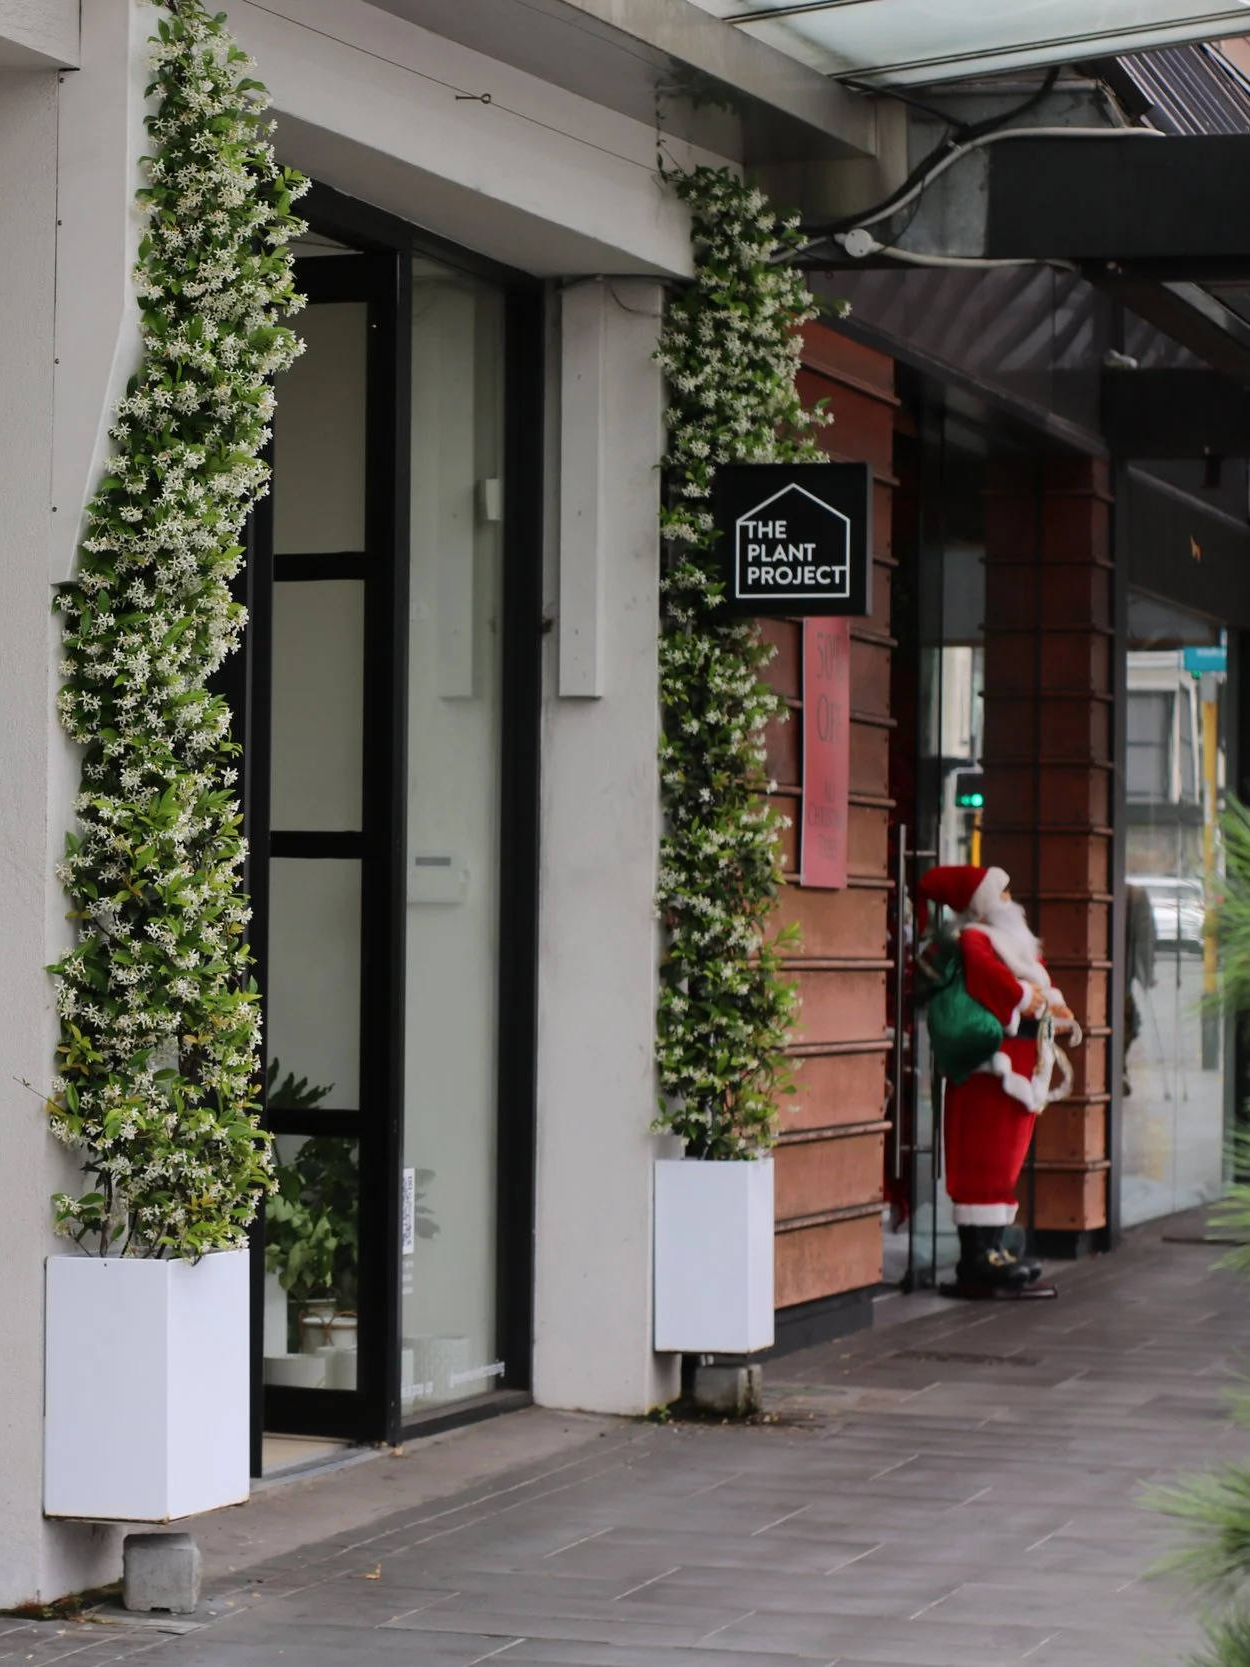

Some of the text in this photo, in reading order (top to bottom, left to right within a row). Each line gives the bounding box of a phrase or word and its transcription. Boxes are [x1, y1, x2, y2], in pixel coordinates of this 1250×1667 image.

[742, 520, 787, 539] THE
[748, 543, 816, 562] PLANT
[748, 565, 847, 585] PROJECT
